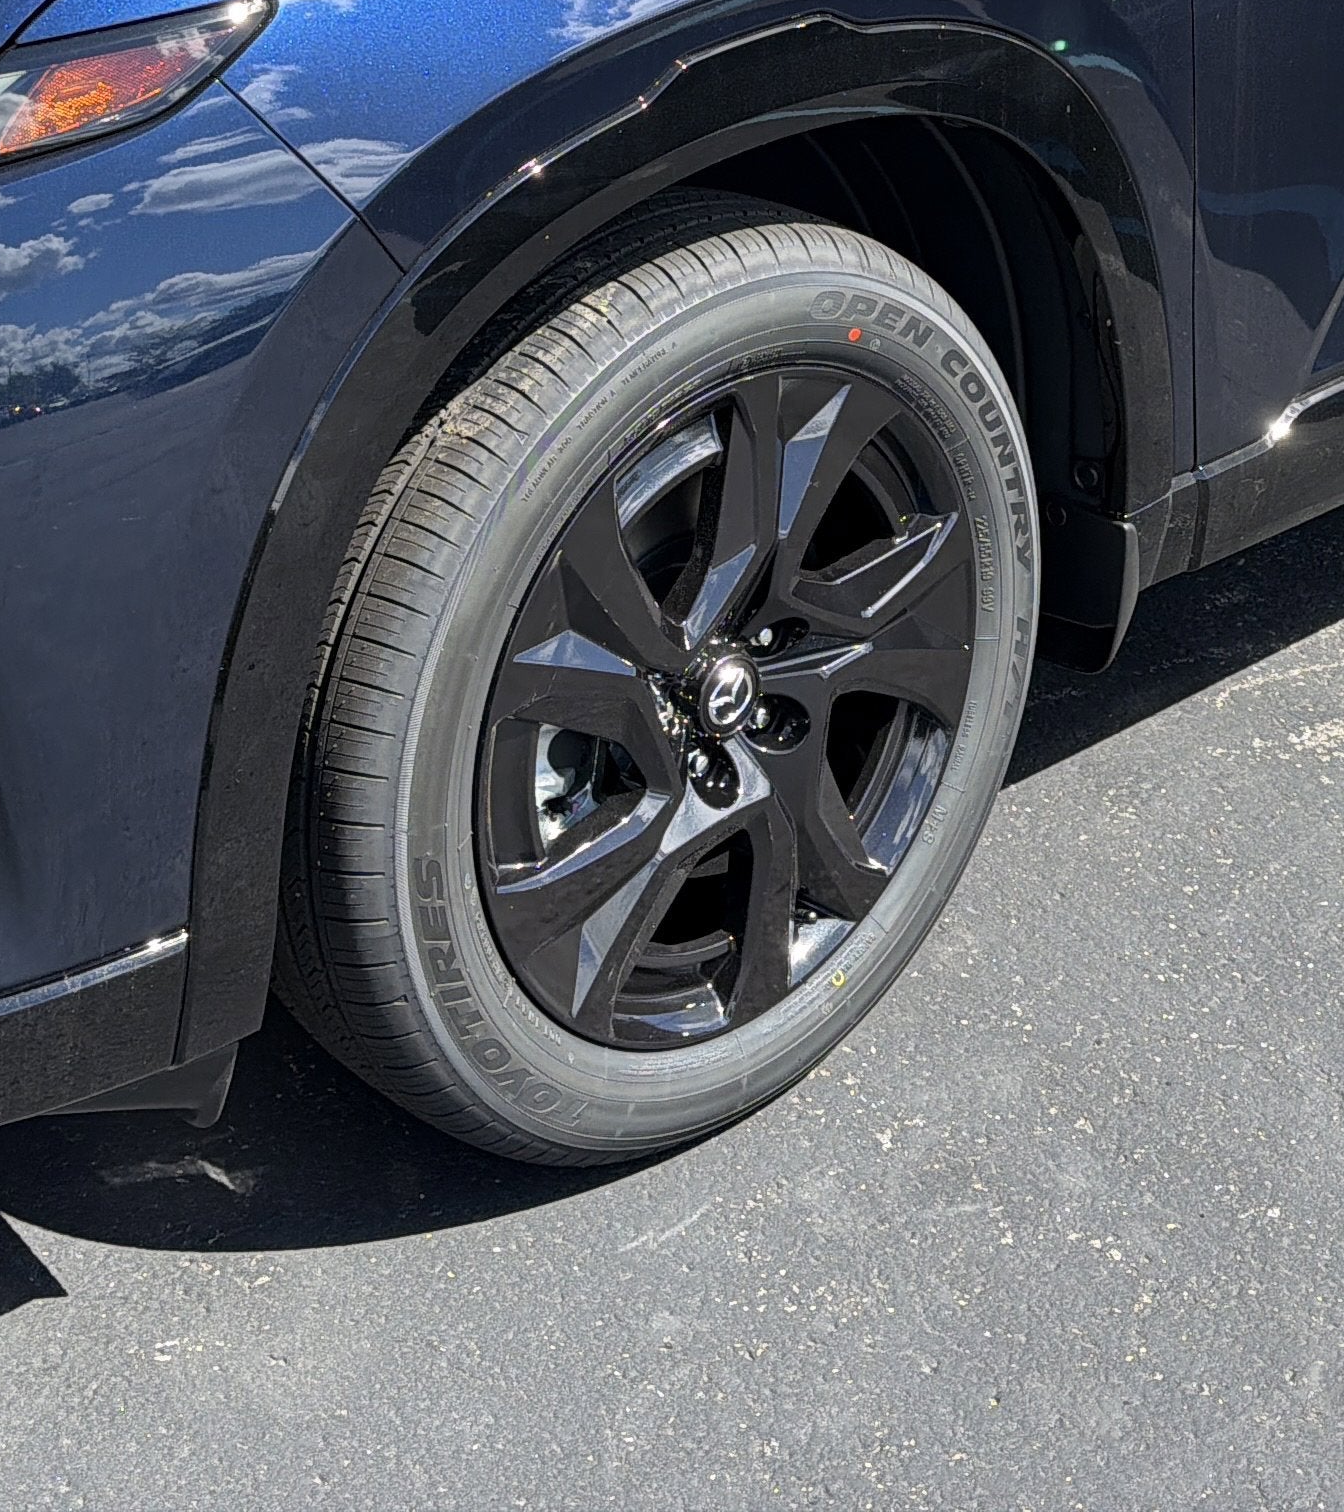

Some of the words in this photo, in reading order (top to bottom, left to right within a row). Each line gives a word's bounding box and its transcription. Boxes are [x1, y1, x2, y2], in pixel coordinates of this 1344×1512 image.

[809, 290, 935, 349] OPEN
[940, 349, 1032, 572] COUNTRY
[922, 804, 948, 845] M+S
[413, 856, 486, 1040] TIRES
[470, 1037, 590, 1128] TOYO
